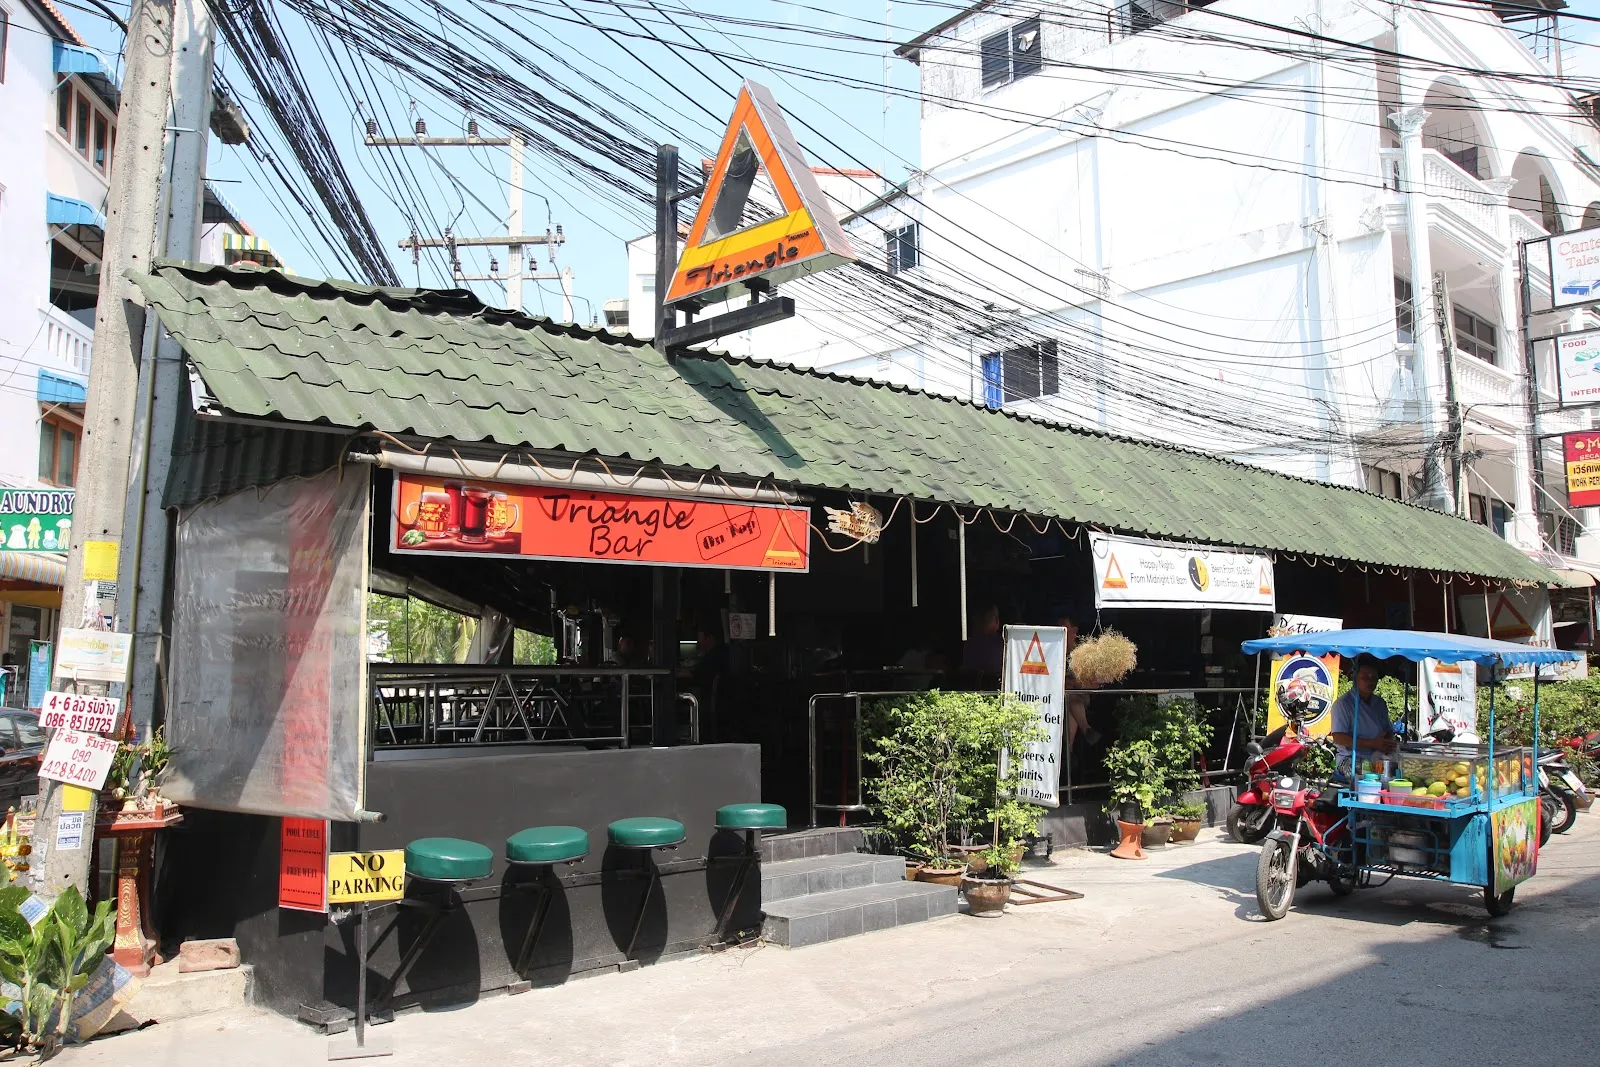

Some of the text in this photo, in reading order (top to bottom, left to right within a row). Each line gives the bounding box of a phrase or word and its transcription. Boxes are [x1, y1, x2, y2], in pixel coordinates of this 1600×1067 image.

[686, 242, 799, 285] Triangle
[1566, 255, 1599, 270] Tales
[1562, 340, 1587, 349] FOOD
[0, 491, 75, 514] AUNDRY
[543, 494, 694, 536] Triangle
[589, 525, 653, 557] Bar
[702, 520, 756, 550] On Top
[766, 557, 797, 567] Triangle
[1139, 557, 1158, 571] Happy
[1130, 572, 1145, 584] From
[1146, 573, 1169, 586] Midnight
[1435, 681, 1460, 689] At the
[72, 696, 85, 712] ล้อ
[87, 697, 116, 716] รับจ้าง
[1042, 693, 1052, 705] of
[1439, 705, 1455, 713] Bar
[1044, 712, 1061, 725] Get
[71, 748, 92, 763] 090
[1048, 752, 1056, 764] &
[43, 760, 97, 783] 4288400
[1019, 768, 1043, 781] pirits
[1030, 788, 1052, 800] 12pm
[286, 827, 320, 839] POOL TABLE
[349, 854, 385, 873] NO
[331, 876, 404, 896] PARKING
